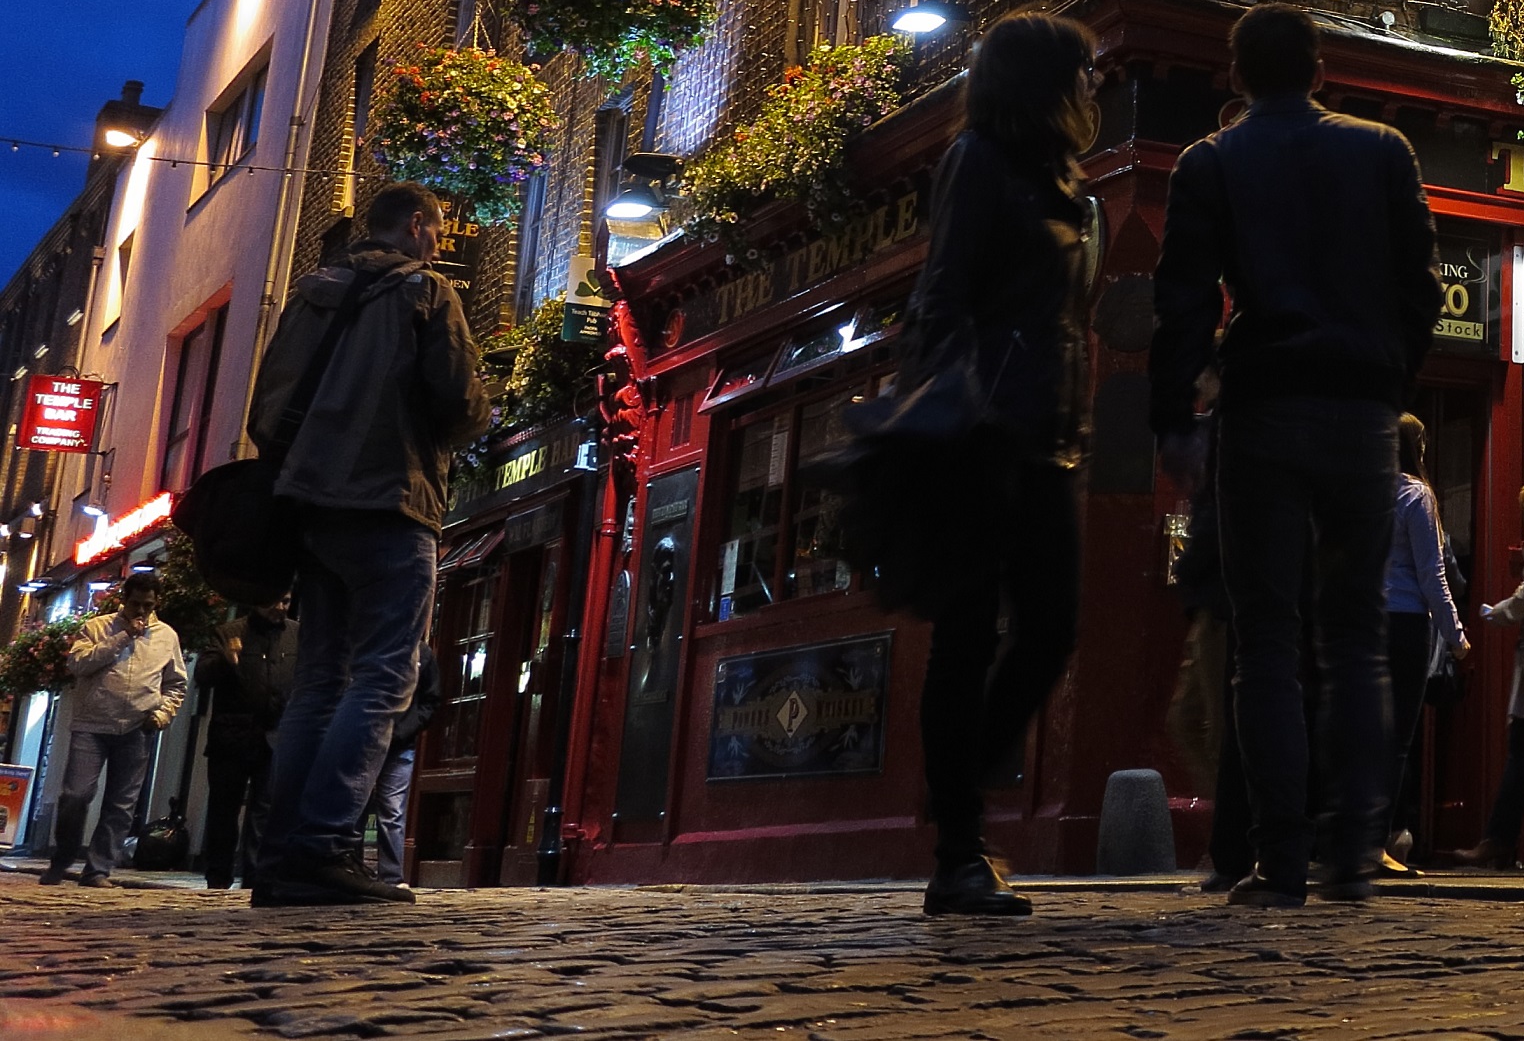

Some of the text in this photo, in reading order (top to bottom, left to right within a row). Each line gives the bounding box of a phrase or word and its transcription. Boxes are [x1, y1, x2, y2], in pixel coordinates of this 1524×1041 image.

[717, 191, 918, 324] THE TEMPLE
[1435, 319, 1481, 337] Stock
[52, 382, 81, 394] THE
[35, 394, 93, 409] TEMPLE
[44, 407, 76, 422] BAR
[36, 427, 81, 438] TRADING
[31, 436, 81, 447] COMPANY
[495, 446, 548, 491] TEMPLE
[787, 698, 801, 734] P
